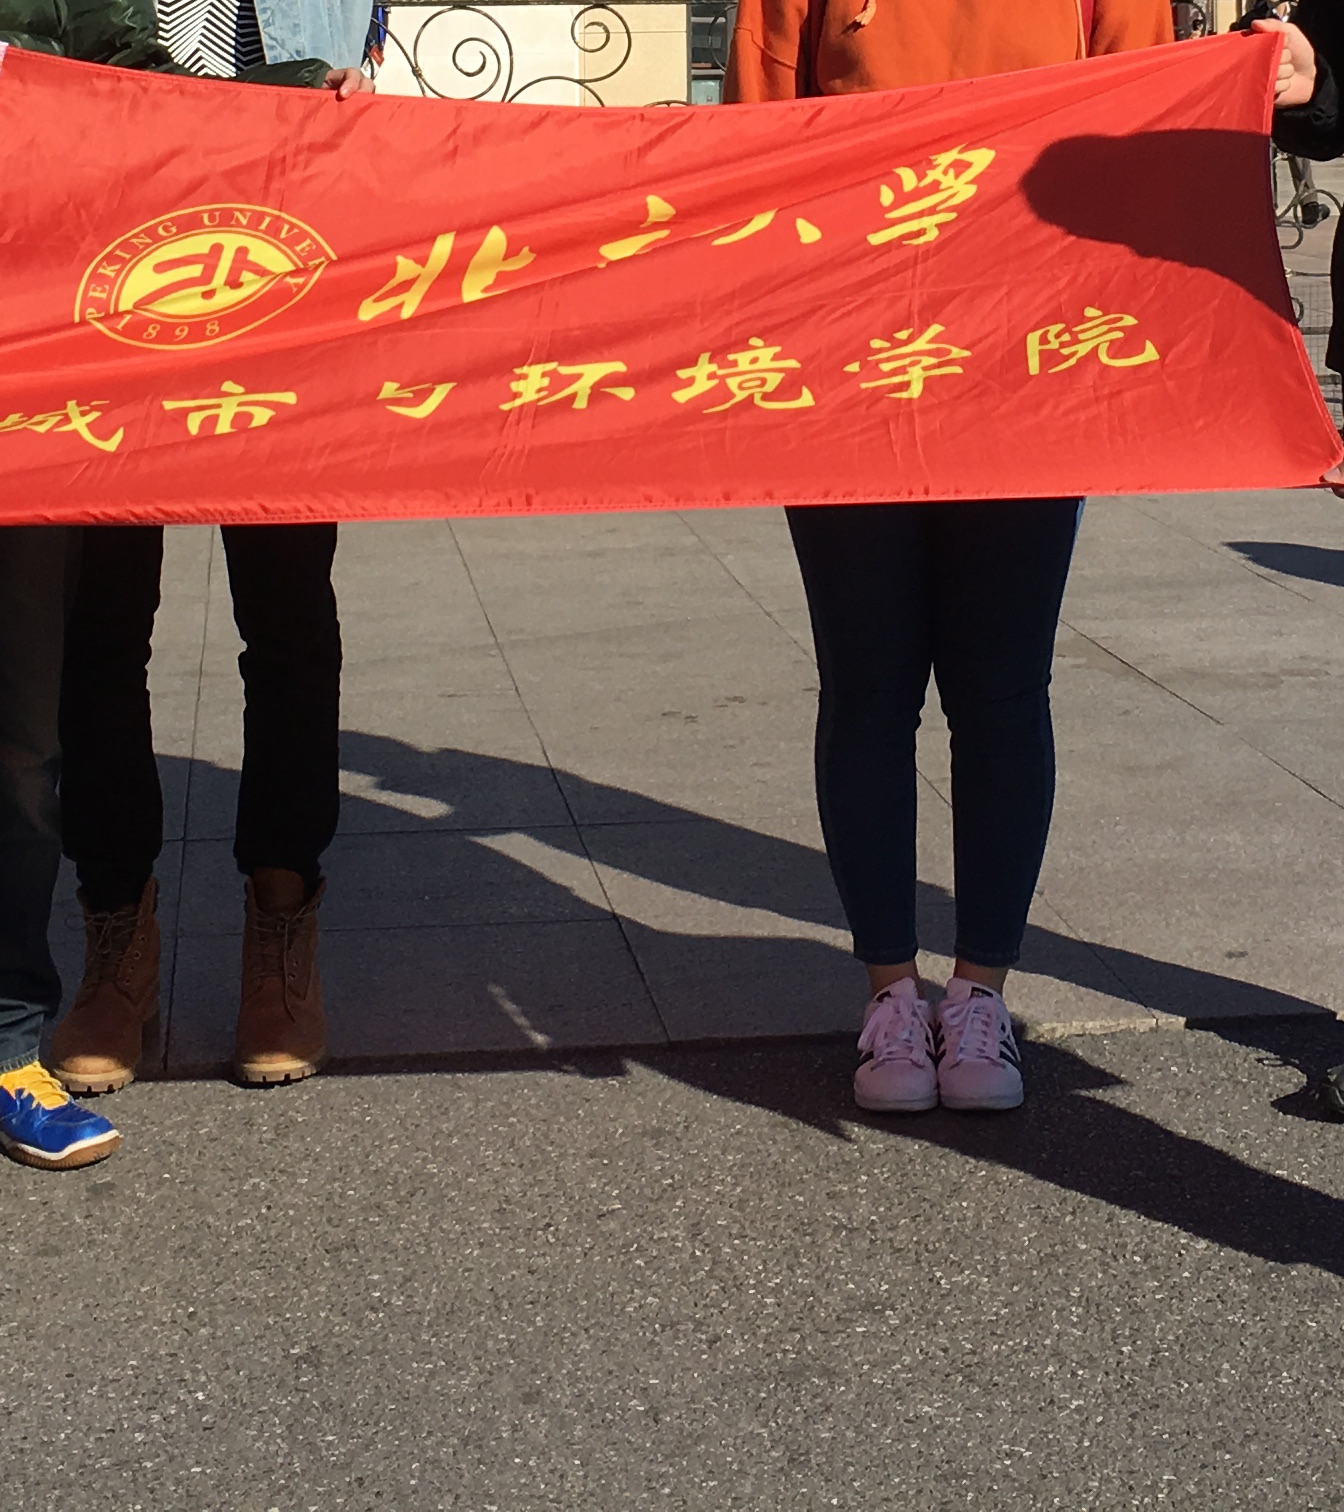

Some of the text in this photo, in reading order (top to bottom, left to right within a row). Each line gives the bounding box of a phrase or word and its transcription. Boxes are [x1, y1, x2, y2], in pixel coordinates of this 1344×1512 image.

[85, 210, 329, 321] PEKING UNIVEY
[115, 313, 221, 342] 1898
